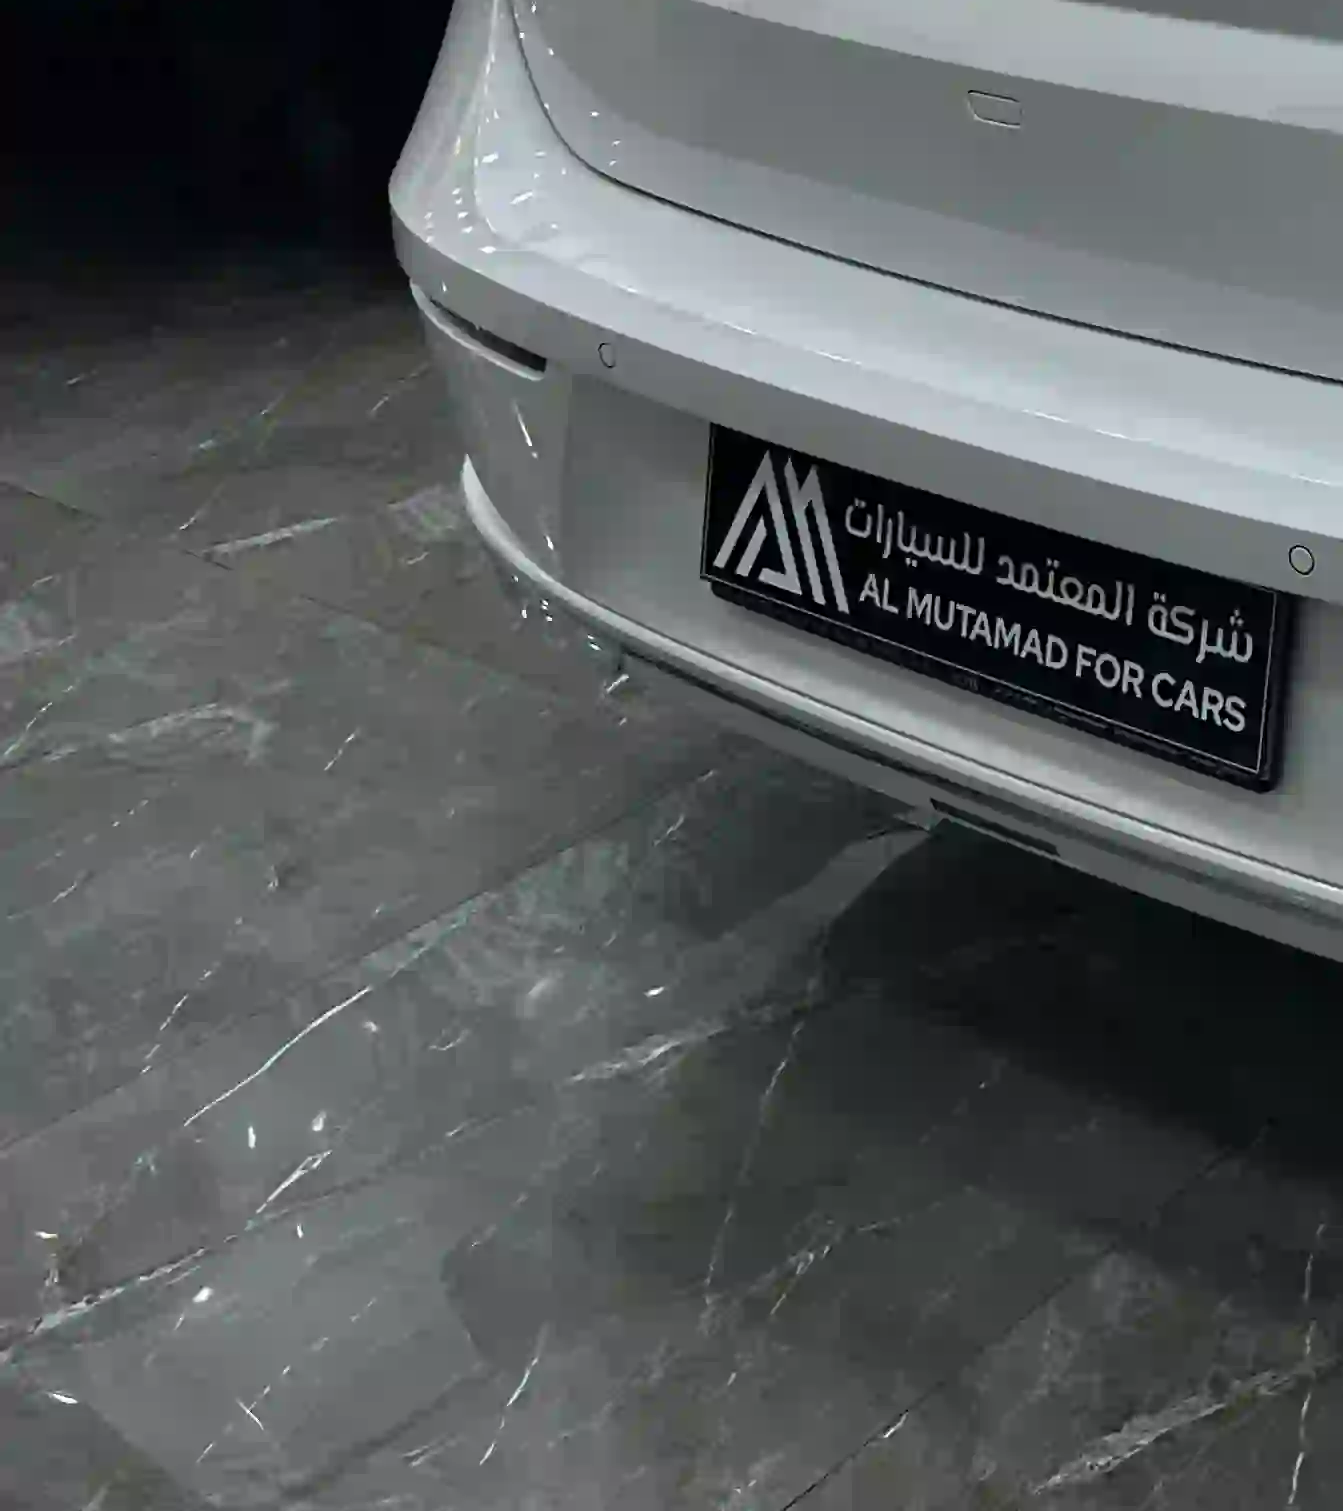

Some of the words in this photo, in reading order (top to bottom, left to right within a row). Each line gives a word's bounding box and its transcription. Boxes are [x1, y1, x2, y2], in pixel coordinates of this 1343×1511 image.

[844, 497, 986, 576] للسيارات
[995, 554, 1135, 626] المعتمد
[1147, 591, 1254, 664] شركة
[859, 572, 899, 615] AL
[906, 586, 1069, 671] MUTAMAD
[1075, 642, 1143, 699] FOR
[1151, 671, 1248, 733] CARS
